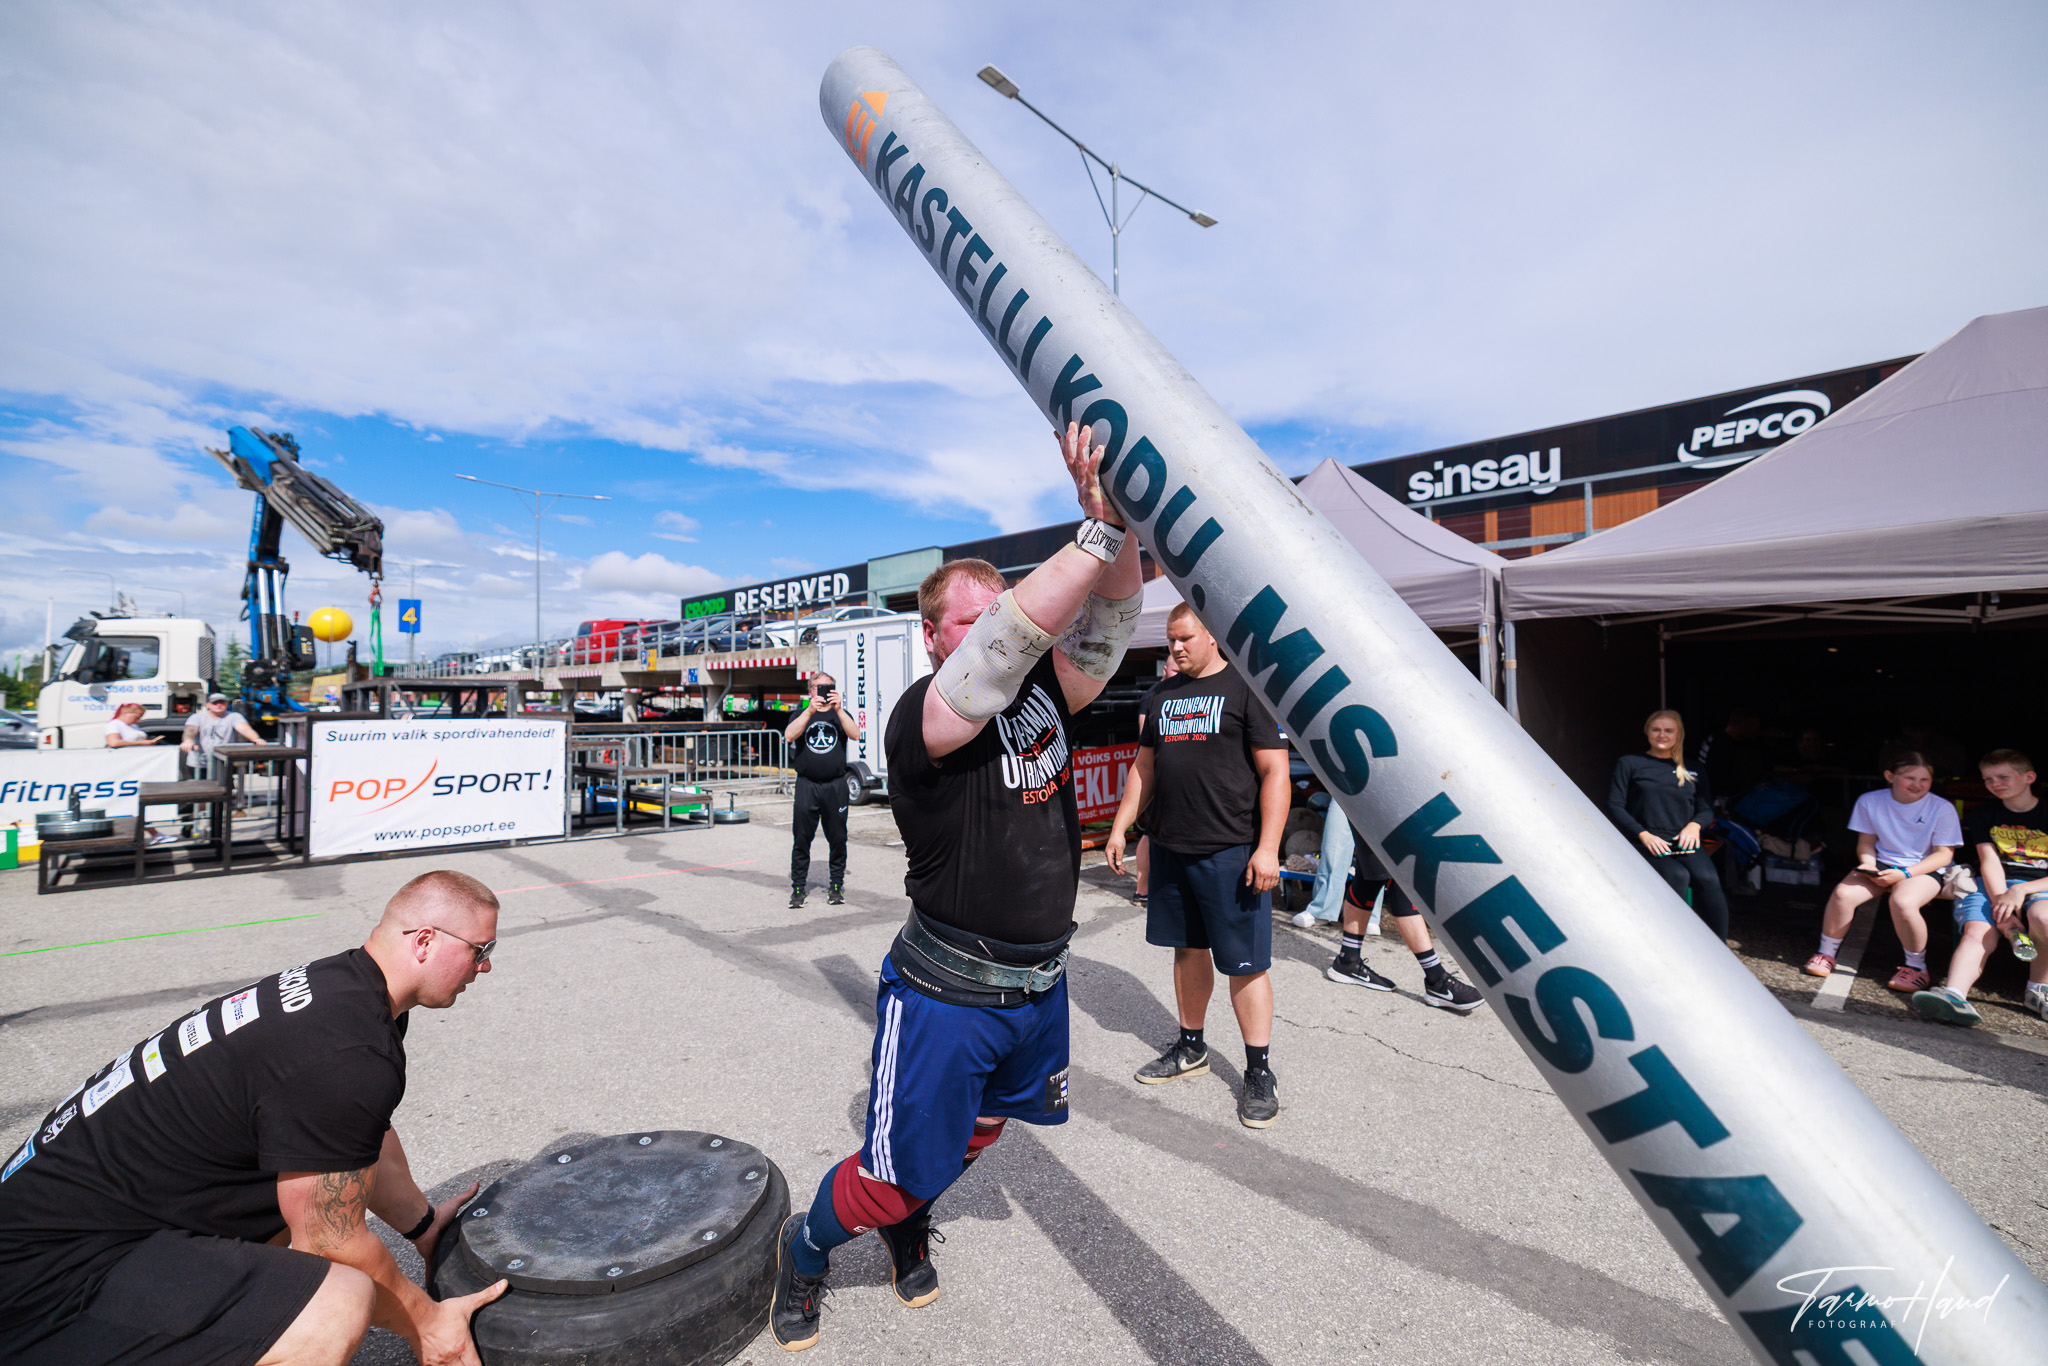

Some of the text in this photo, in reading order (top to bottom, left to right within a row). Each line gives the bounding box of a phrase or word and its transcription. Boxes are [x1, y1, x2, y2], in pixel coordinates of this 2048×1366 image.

[1690, 407, 1817, 451] PEPCO
[875, 130, 1053, 384] KASTELLI
[1048, 353, 1224, 612] KODU.
[1226, 584, 1398, 796] MIS
[1408, 447, 1562, 502] sinsay
[734, 573, 850, 615] RESERVED
[402, 606, 418, 625] 4
[1160, 696, 1225, 721] STRONGMAN
[326, 728, 555, 743] Suurim valik spordivahendeid!
[1158, 714, 1222, 736] STRONGWOMAN
[1164, 733, 1207, 743] ESTONIA 2026
[1077, 752, 1111, 766] VÕIKS
[329, 769, 552, 802] POP SPORT!
[1022, 781, 1058, 805] ESTOIA
[1073, 762, 1128, 809] EKLA
[374, 821, 516, 841] www.popsport.ee
